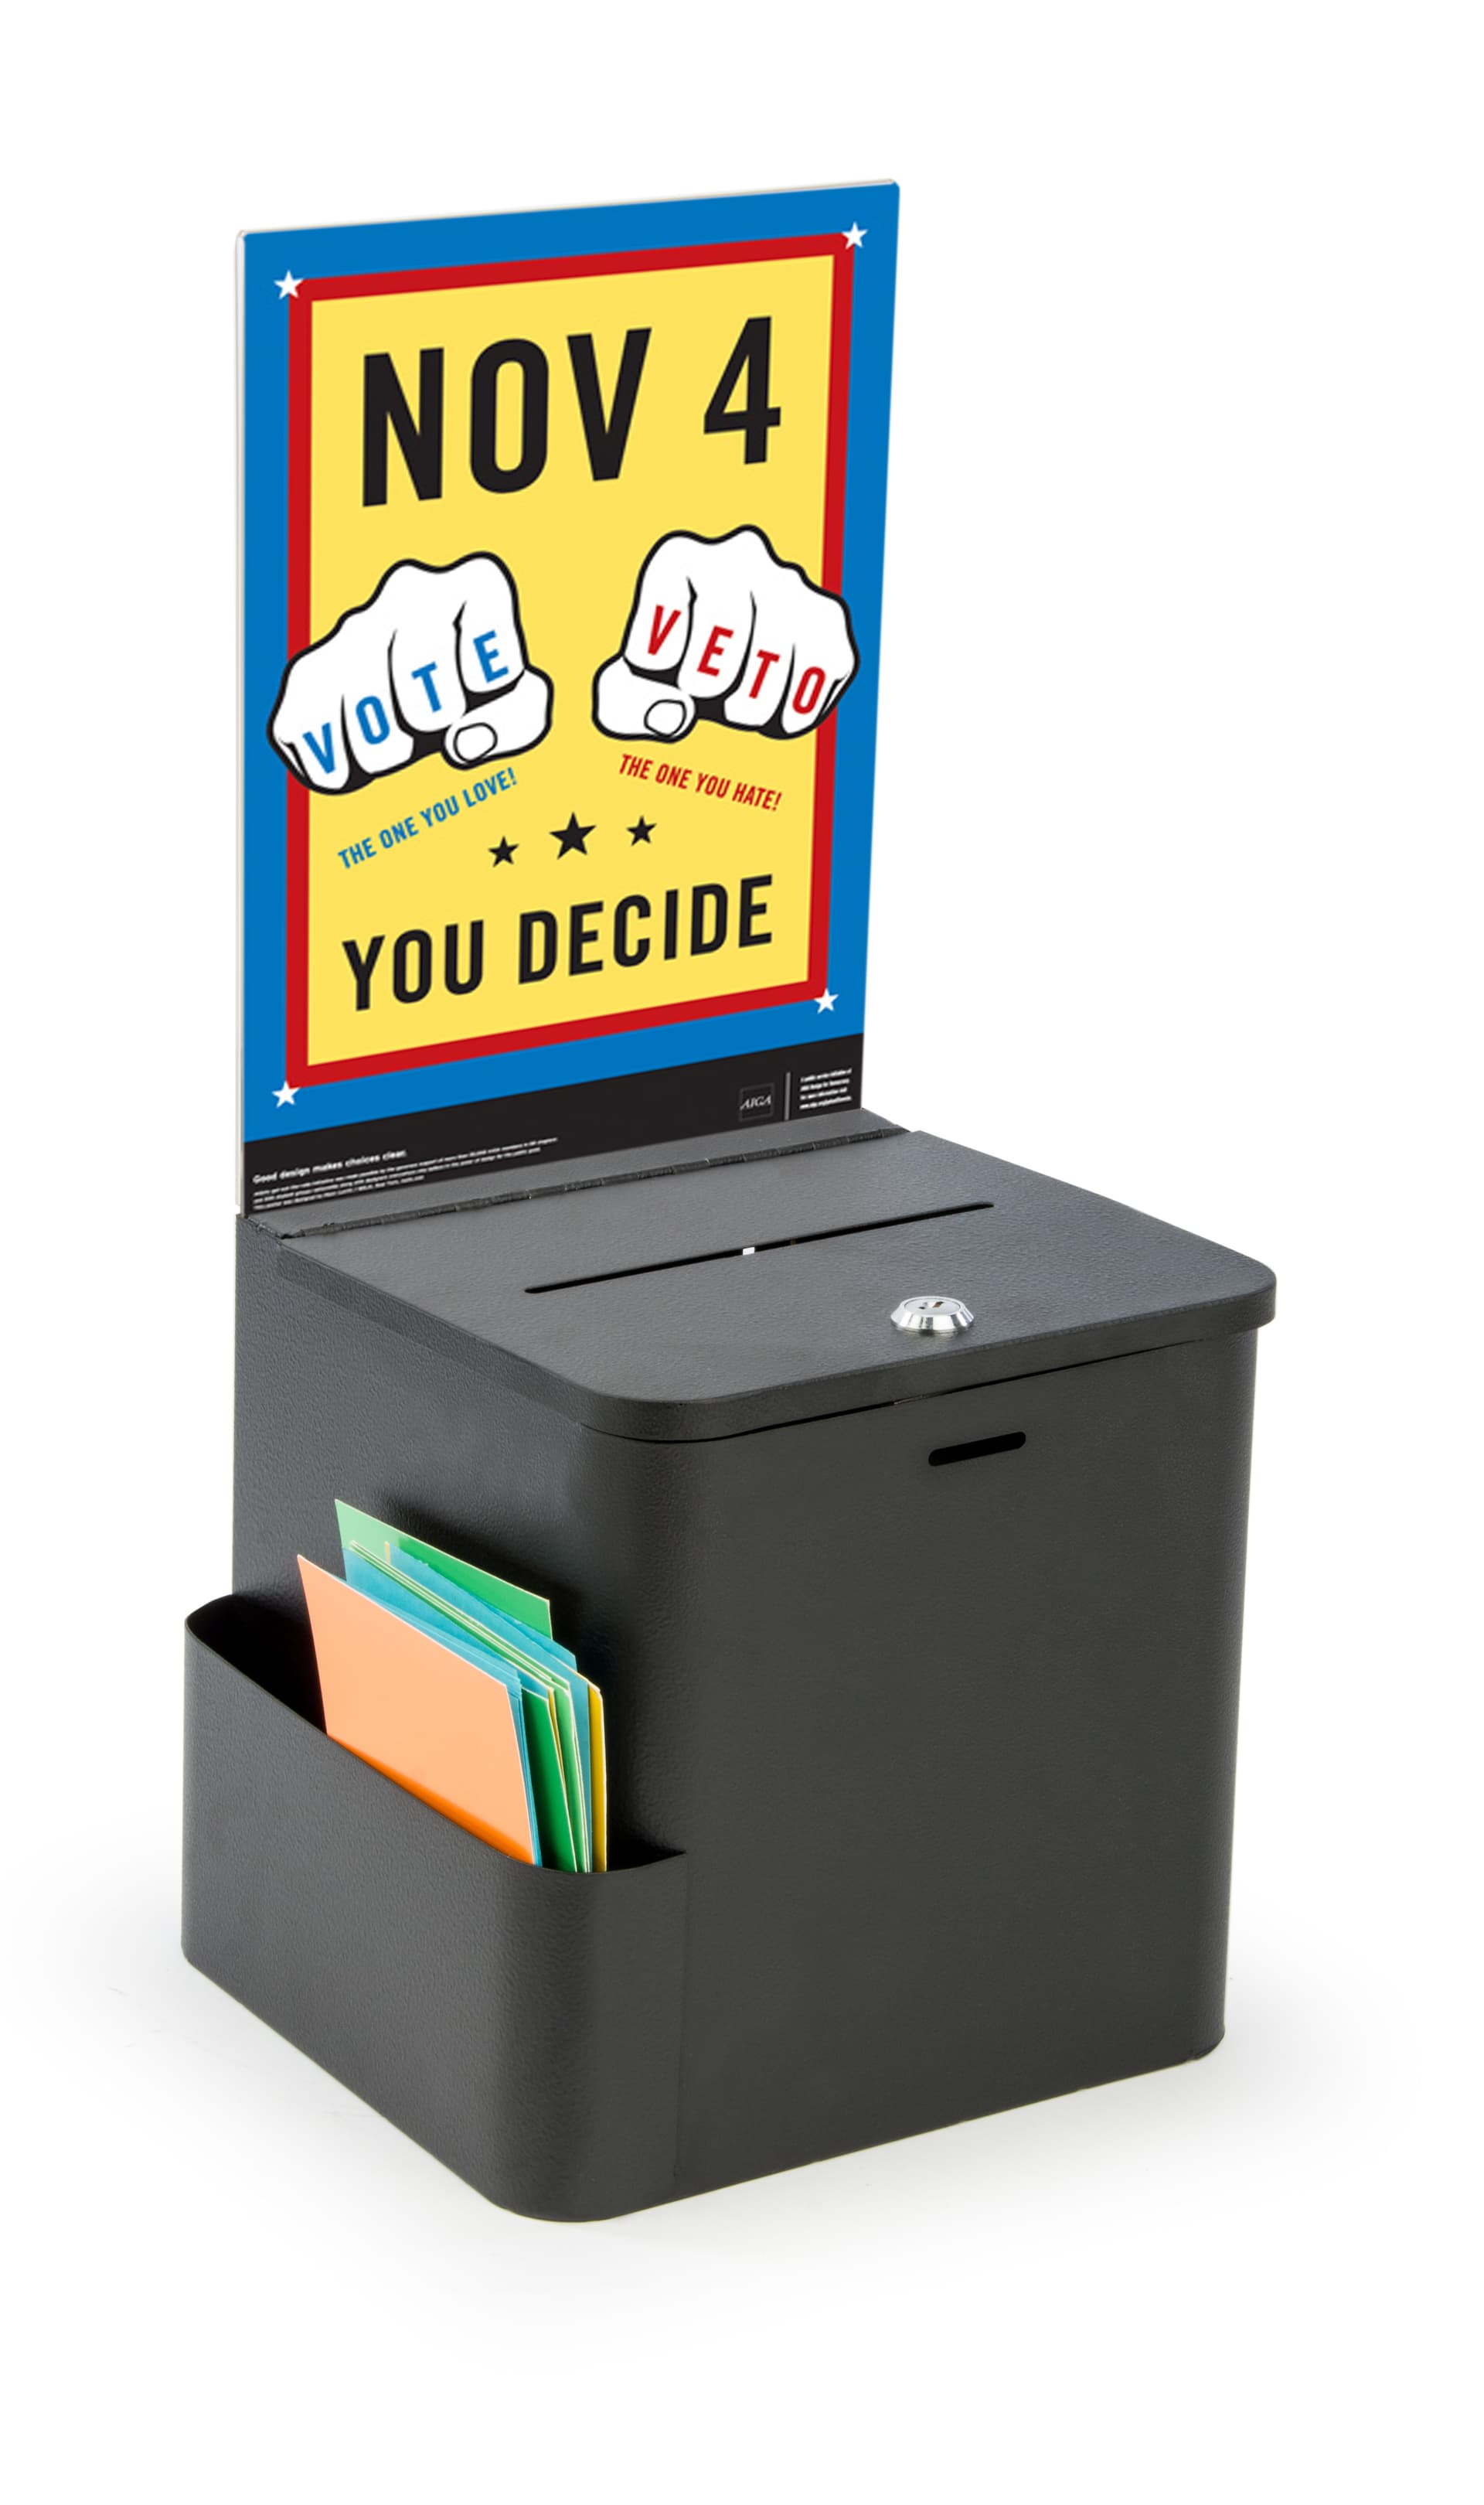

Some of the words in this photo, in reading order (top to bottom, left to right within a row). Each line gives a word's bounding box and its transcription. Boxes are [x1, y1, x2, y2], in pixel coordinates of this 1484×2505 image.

[363, 328, 651, 506] NOV
[704, 316, 781, 464] 4
[302, 630, 509, 774] VOTE
[648, 605, 825, 714] VETO
[337, 837, 377, 869] THE
[379, 816, 419, 849] ONE
[420, 796, 460, 827] YOU
[462, 767, 516, 808] LOVE!
[619, 754, 653, 780] THE
[655, 763, 693, 789] ONE
[696, 772, 731, 799] YOU
[732, 782, 783, 809] HATE!
[342, 920, 484, 1011] YOU
[519, 874, 772, 984] DECIDE
[740, 1095, 772, 1110] AIGA
[252, 1171, 278, 1184] Good
[279, 1167, 311, 1179] design
[311, 1161, 343, 1173] makes
[345, 1155, 381, 1167] choices
